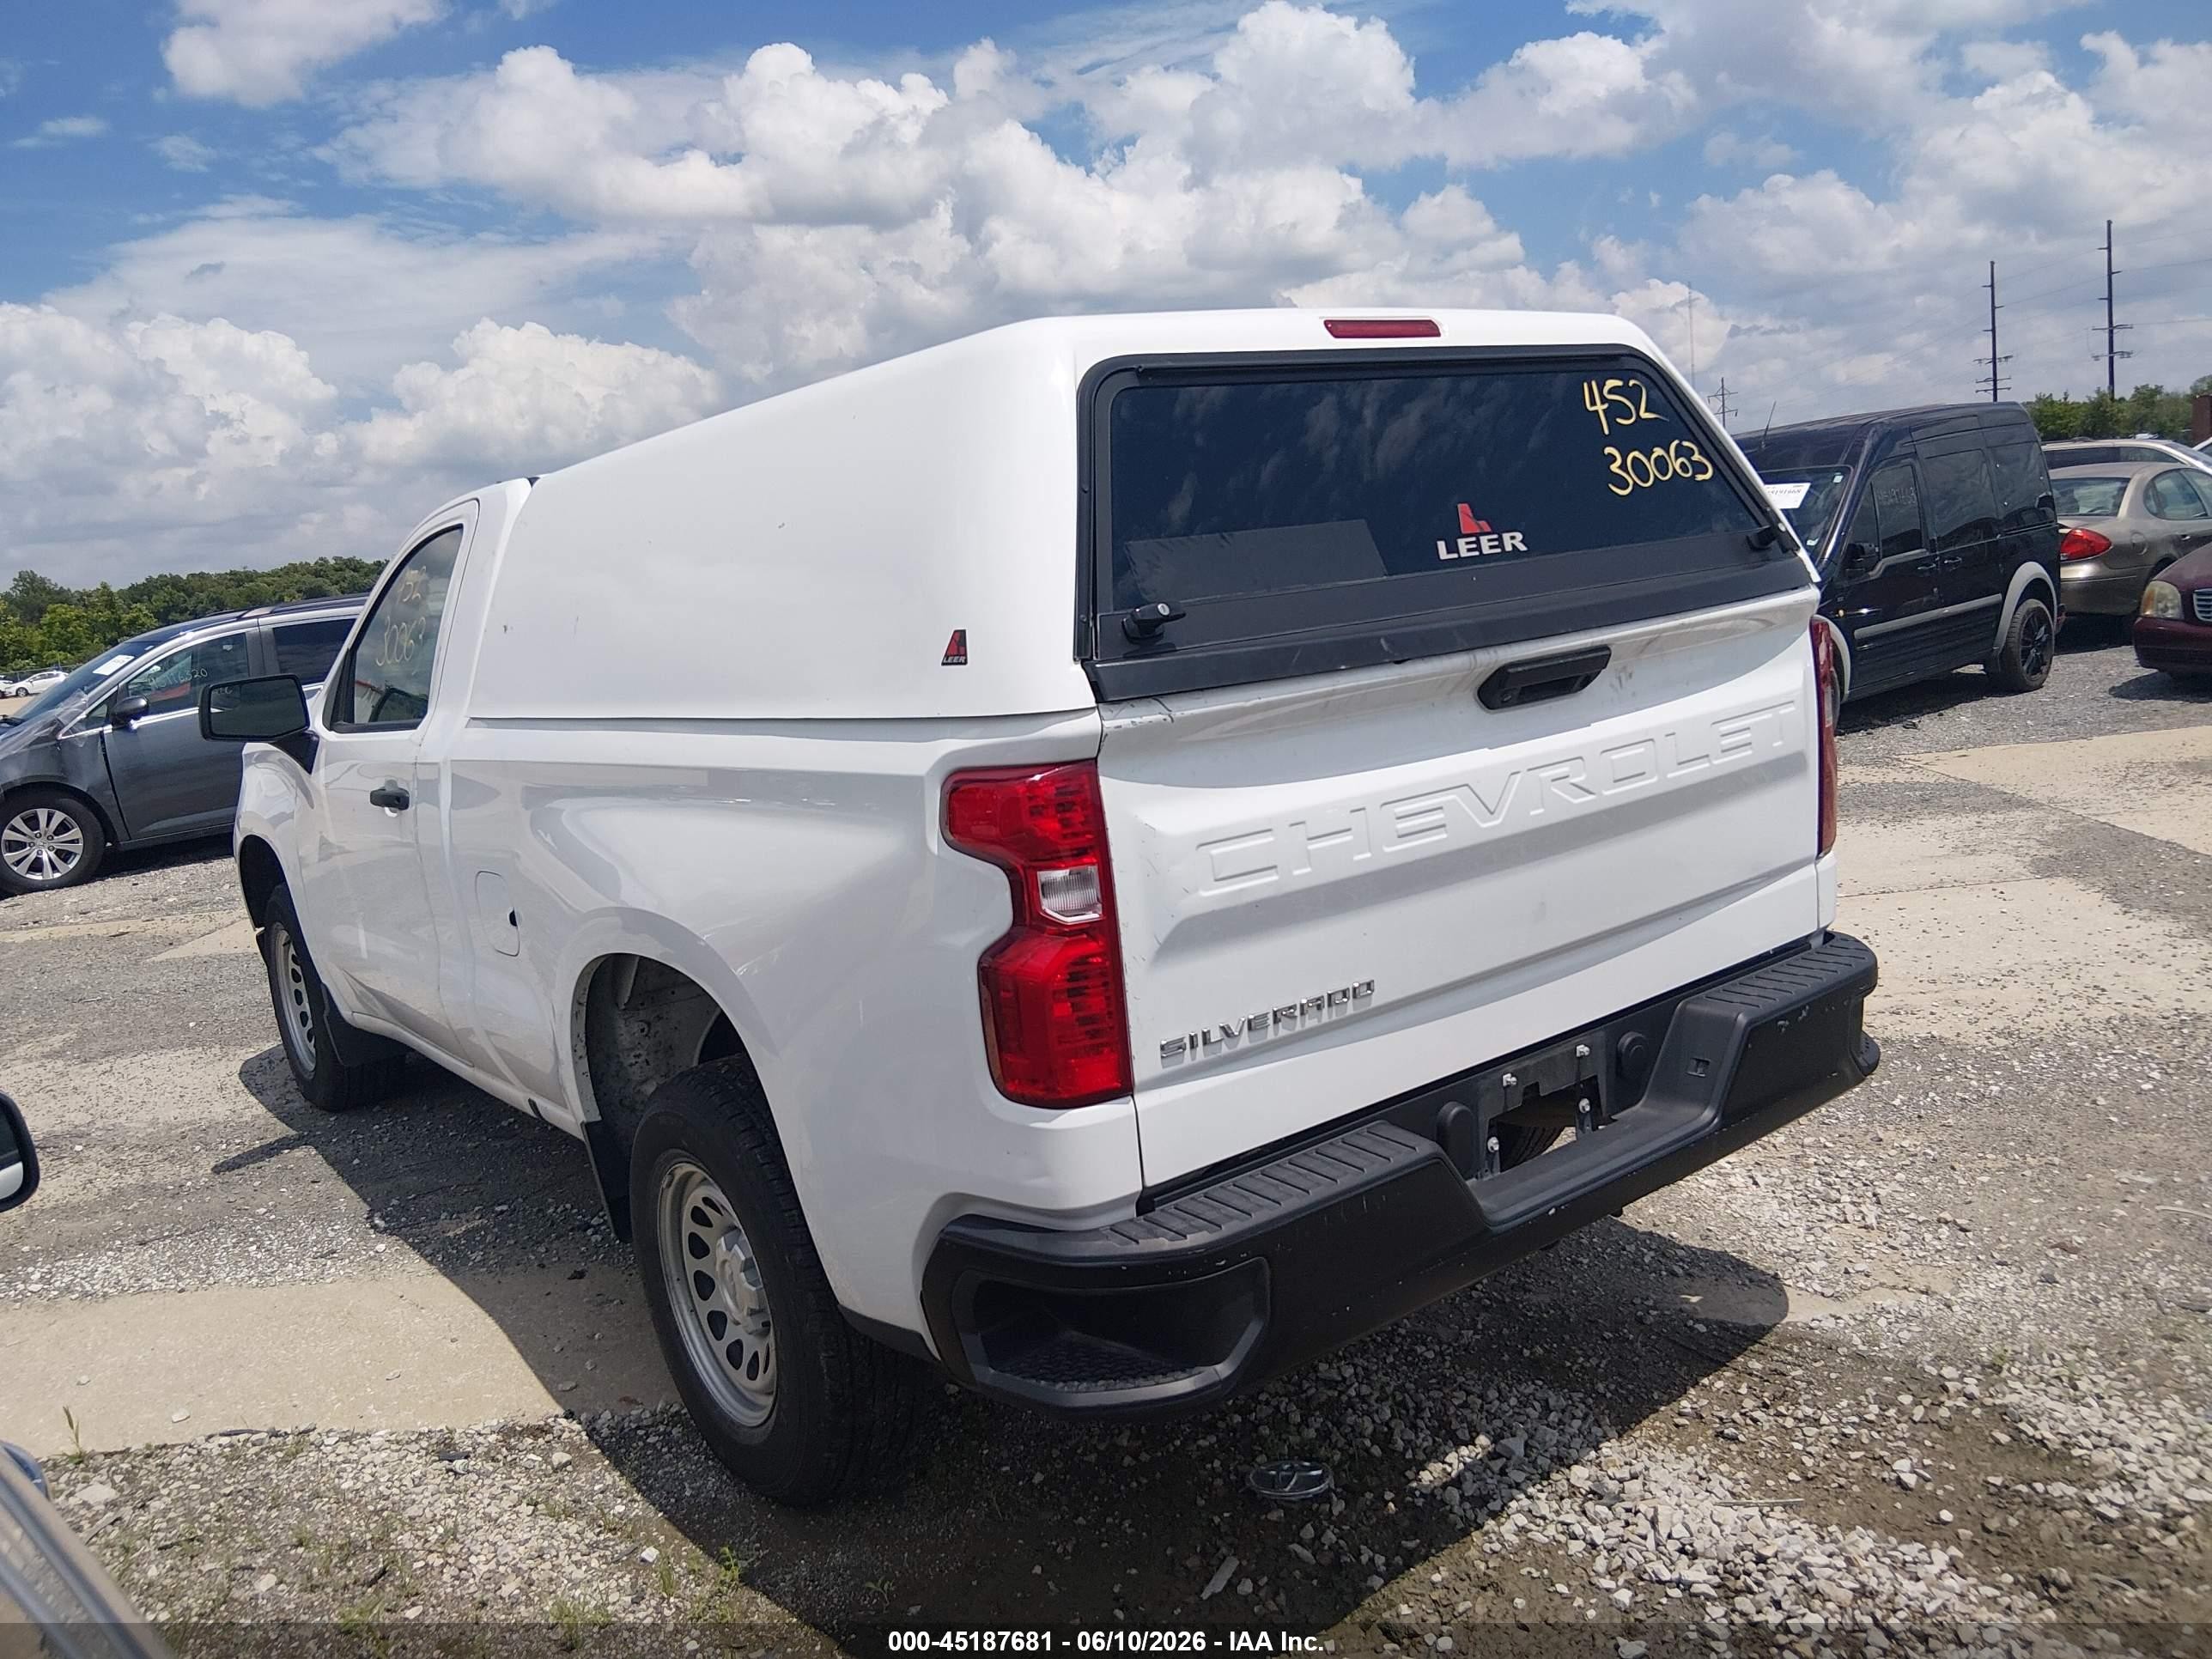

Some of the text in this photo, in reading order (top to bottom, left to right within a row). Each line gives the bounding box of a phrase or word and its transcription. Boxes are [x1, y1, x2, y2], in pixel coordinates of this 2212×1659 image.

[1583, 379, 1669, 435] 452
[1604, 440, 1713, 495] 30063
[1436, 531, 1528, 561] LEER
[1194, 700, 1798, 897] CHEVROLET
[1159, 979, 1376, 1059] SILVERADO
